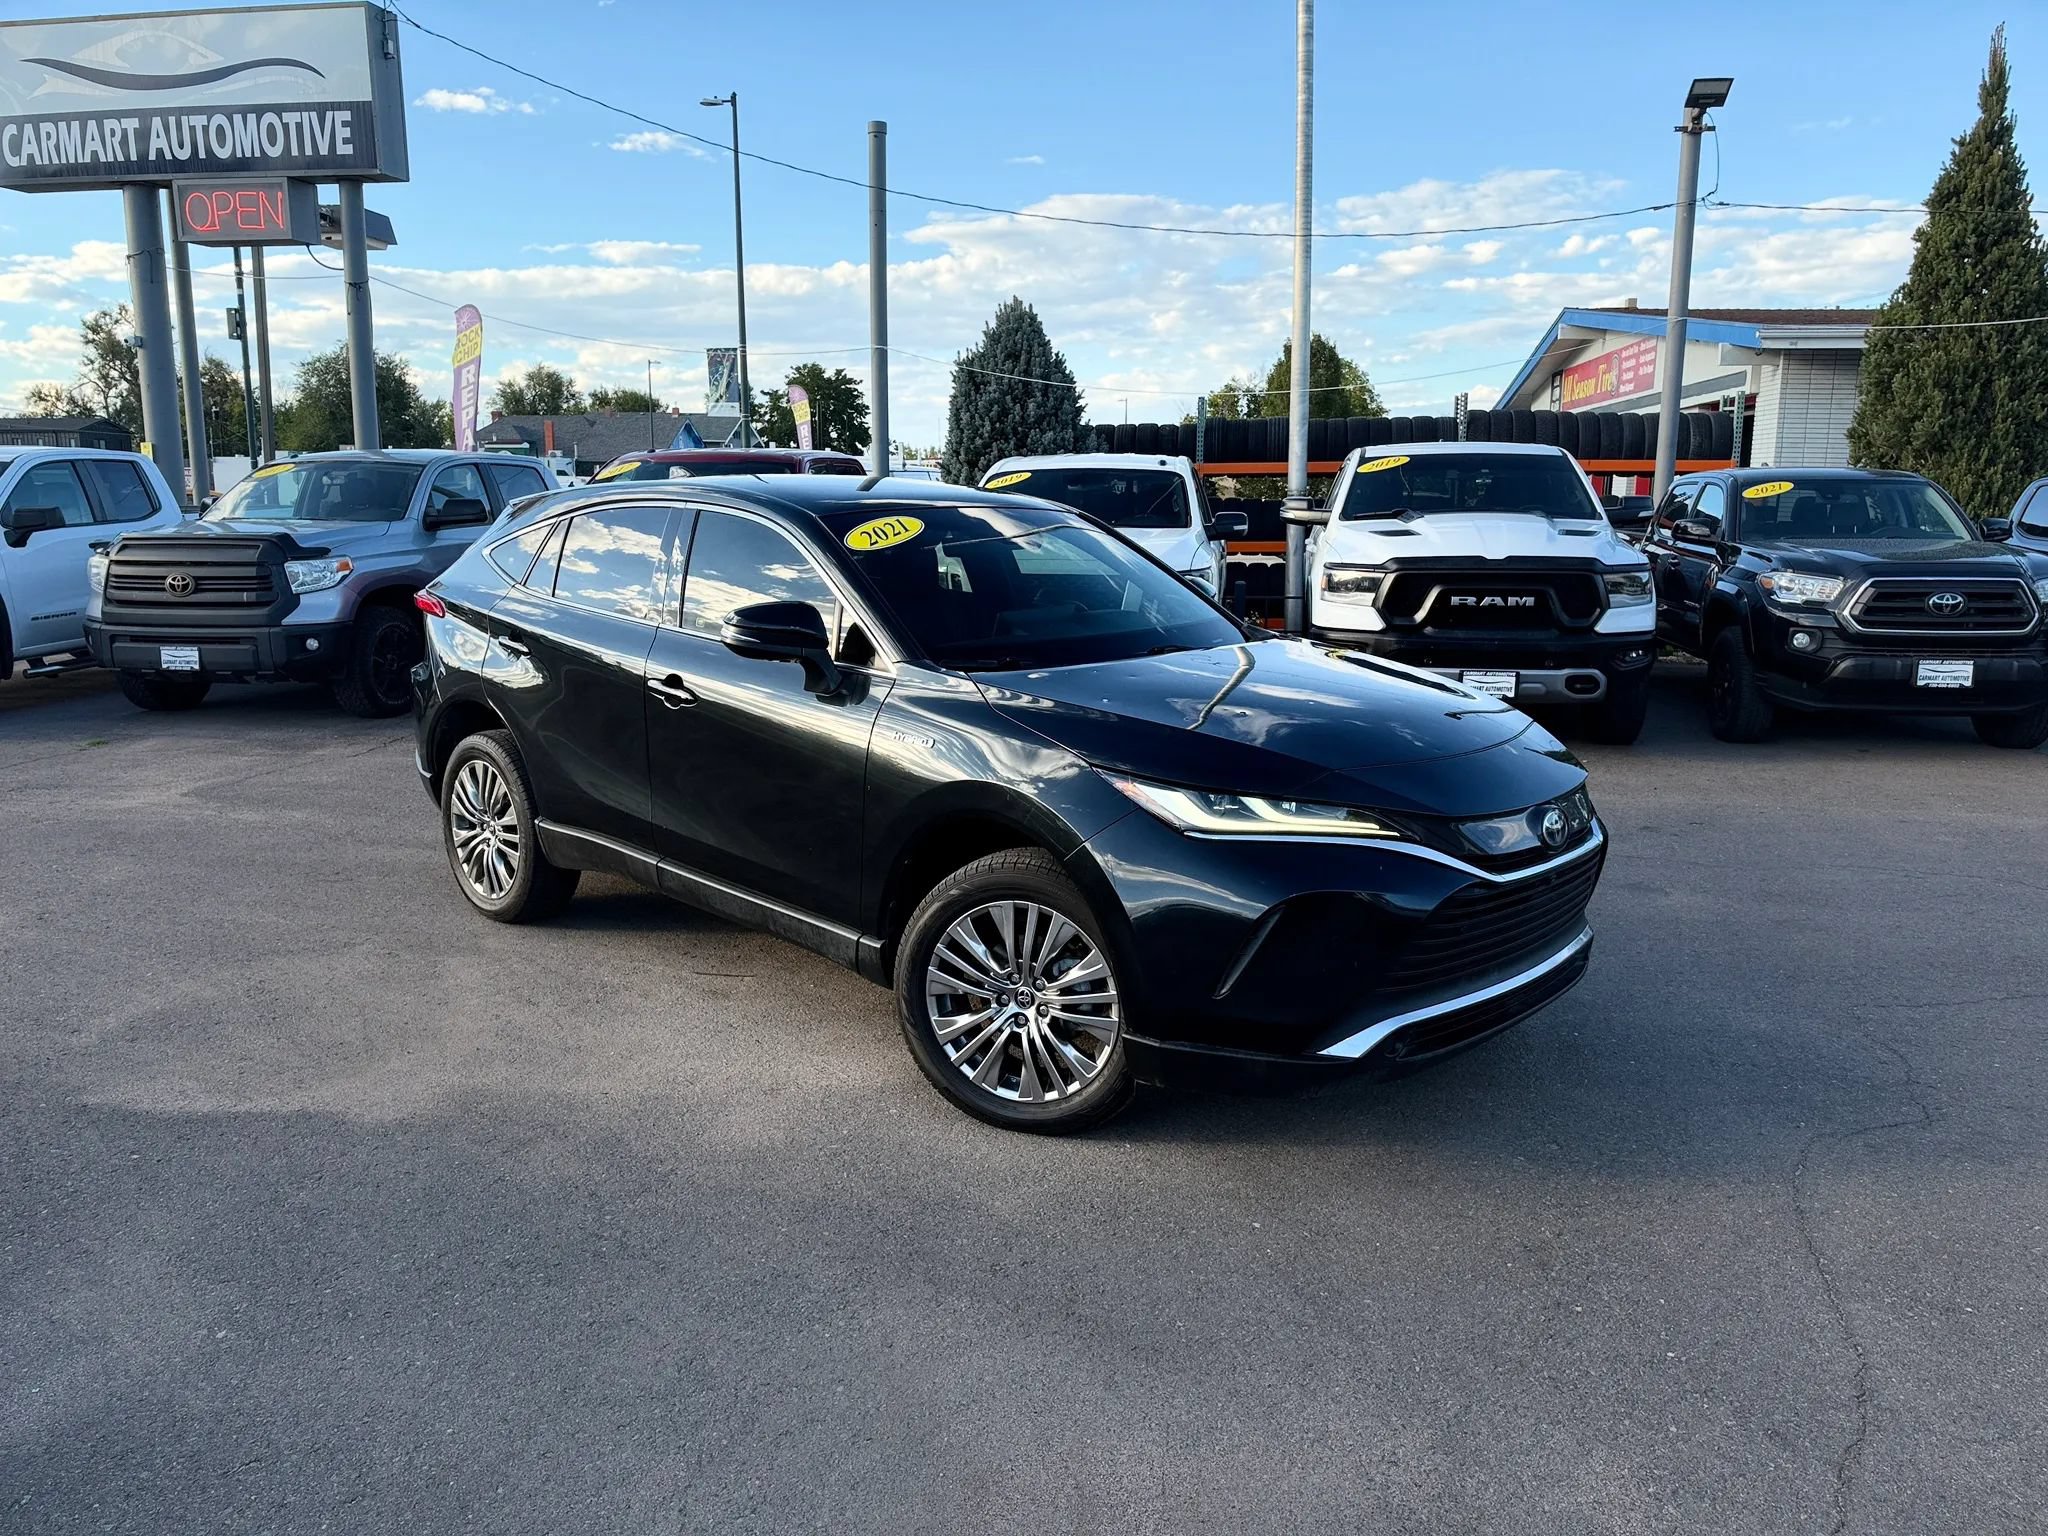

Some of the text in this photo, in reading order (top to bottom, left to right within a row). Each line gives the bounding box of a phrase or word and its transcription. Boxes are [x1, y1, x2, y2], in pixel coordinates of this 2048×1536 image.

[2, 110, 355, 168] CARMART AUTOMOTIVE
[185, 191, 284, 231] OPEN
[455, 341, 479, 364] CHIP
[1573, 373, 1597, 401] Season
[1367, 457, 1401, 471] 2019
[1753, 483, 1782, 496] 2021
[860, 519, 910, 547] 2021
[1450, 596, 1535, 607] RAM
